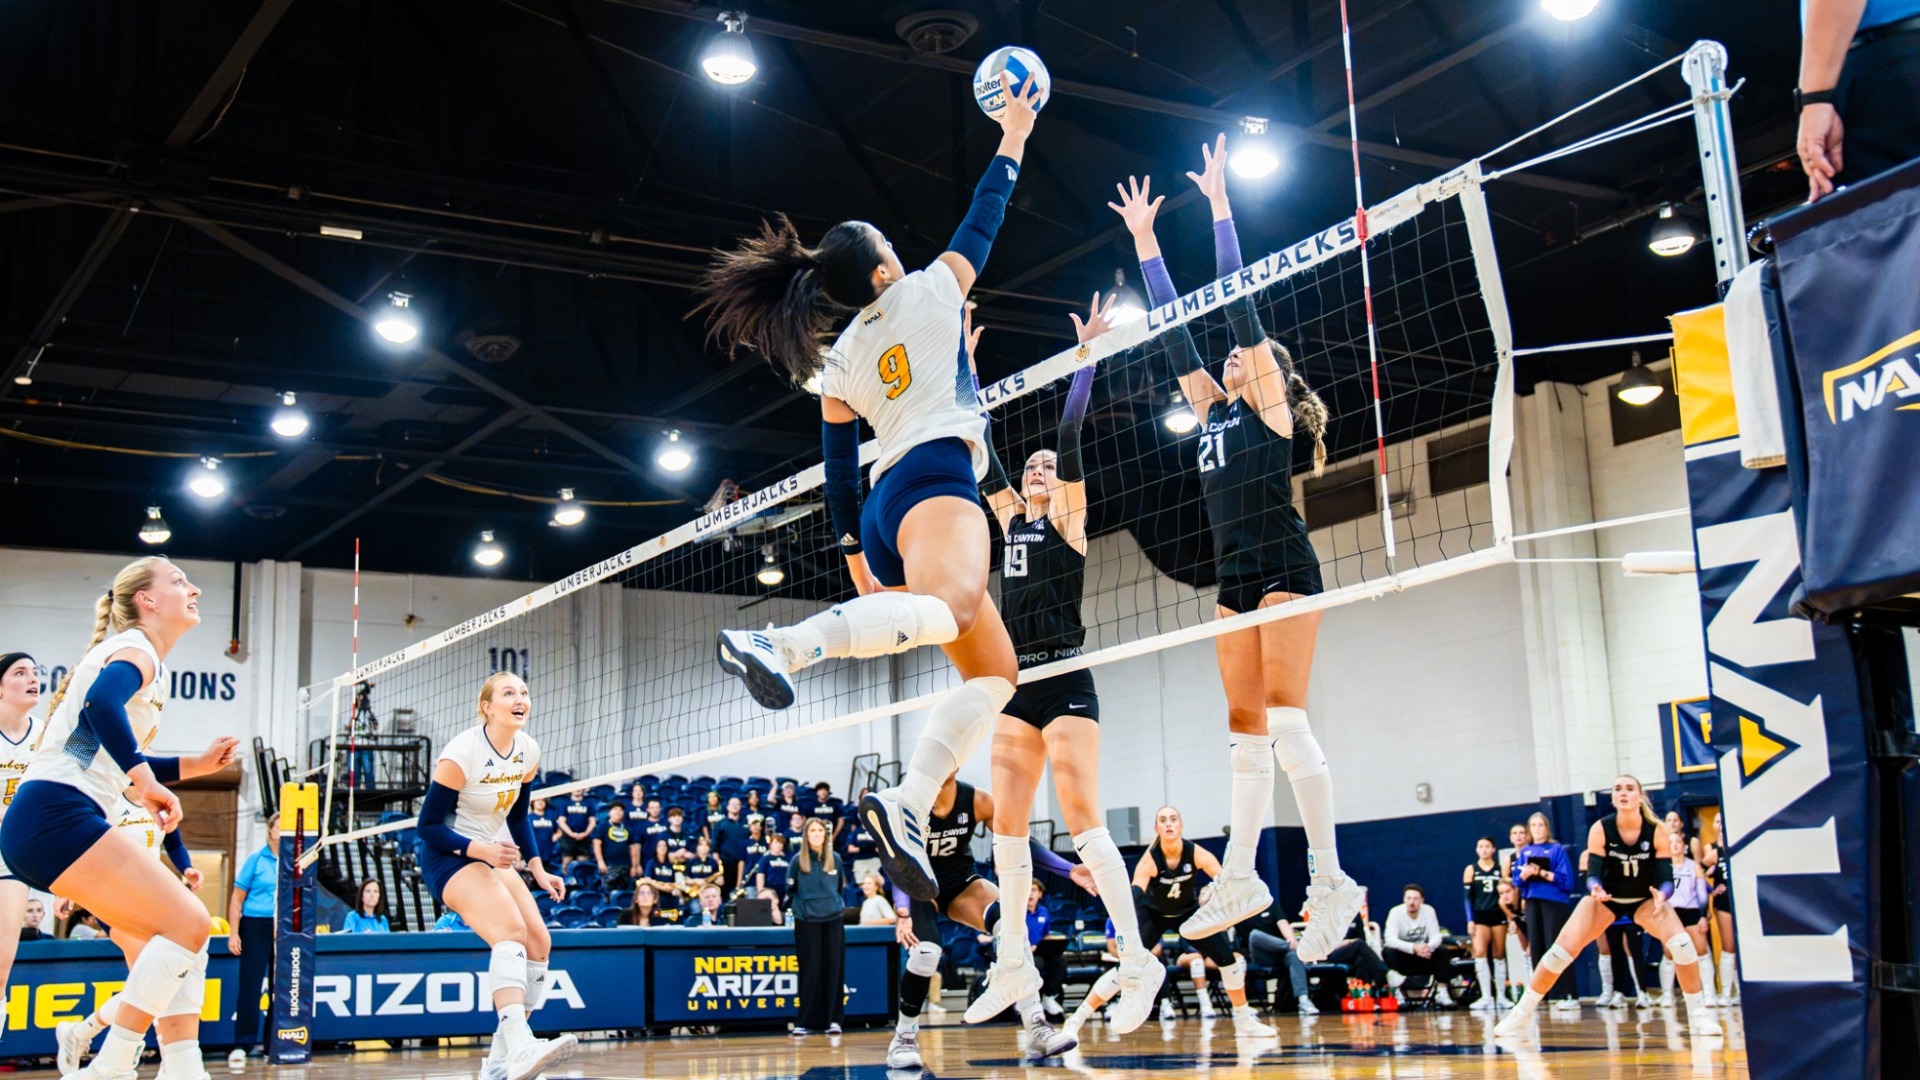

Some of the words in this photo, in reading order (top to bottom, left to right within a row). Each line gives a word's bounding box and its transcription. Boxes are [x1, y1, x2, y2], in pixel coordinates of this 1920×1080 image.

[1146, 220, 1356, 332] LUMBERJACKS
[863, 311, 881, 326] NAU
[877, 343, 912, 400] 9
[1838, 352, 1920, 422] NA
[1198, 430, 1226, 474] 21
[695, 475, 798, 533] LUMBERJACKS
[554, 550, 632, 595] LUMBERJACKS
[1003, 543, 1029, 578] 19
[443, 606, 507, 642] LUMBERJACKS
[1018, 650, 1049, 665] PRO
[1695, 506, 1854, 983] NAU
[929, 836, 958, 857] 12
[1482, 879, 1494, 893] 3
[1620, 859, 1640, 878] 11
[1167, 882, 1182, 899] 4
[694, 955, 800, 974] NORTHE
[230, 968, 587, 1021] RIZOA
[688, 974, 800, 998] ARIZO
[281, 1031, 305, 1040] NAU
